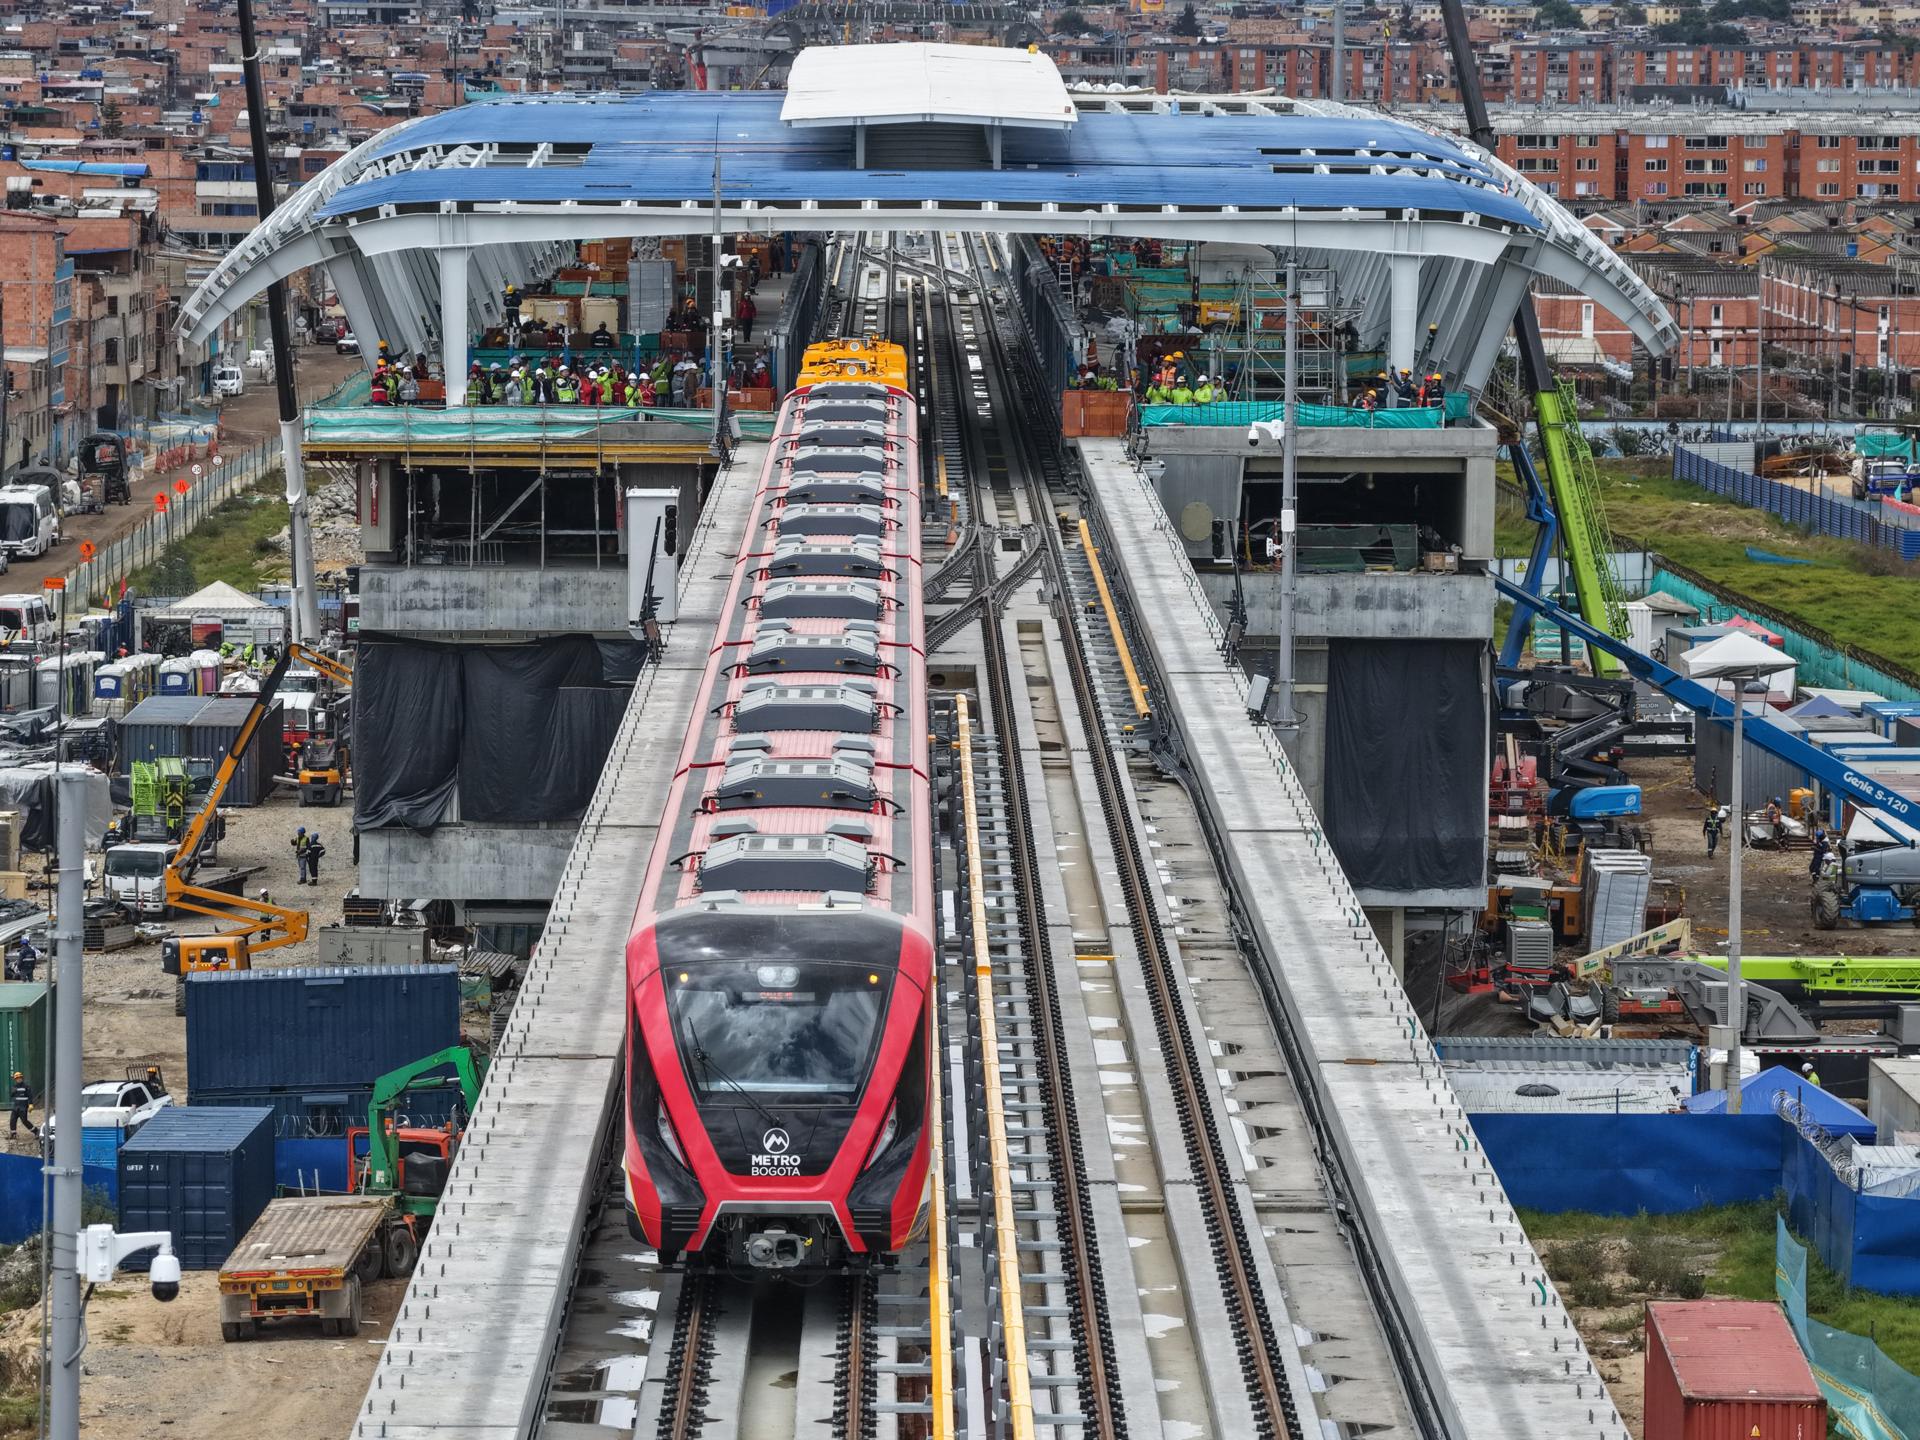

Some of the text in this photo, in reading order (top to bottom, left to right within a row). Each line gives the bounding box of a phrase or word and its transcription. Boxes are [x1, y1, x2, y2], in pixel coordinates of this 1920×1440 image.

[1843, 771, 1909, 814] Genie S-120
[1634, 935, 1649, 952] LIFT
[751, 1154, 801, 1166] METRO
[751, 1166, 801, 1176] BOGOTA
